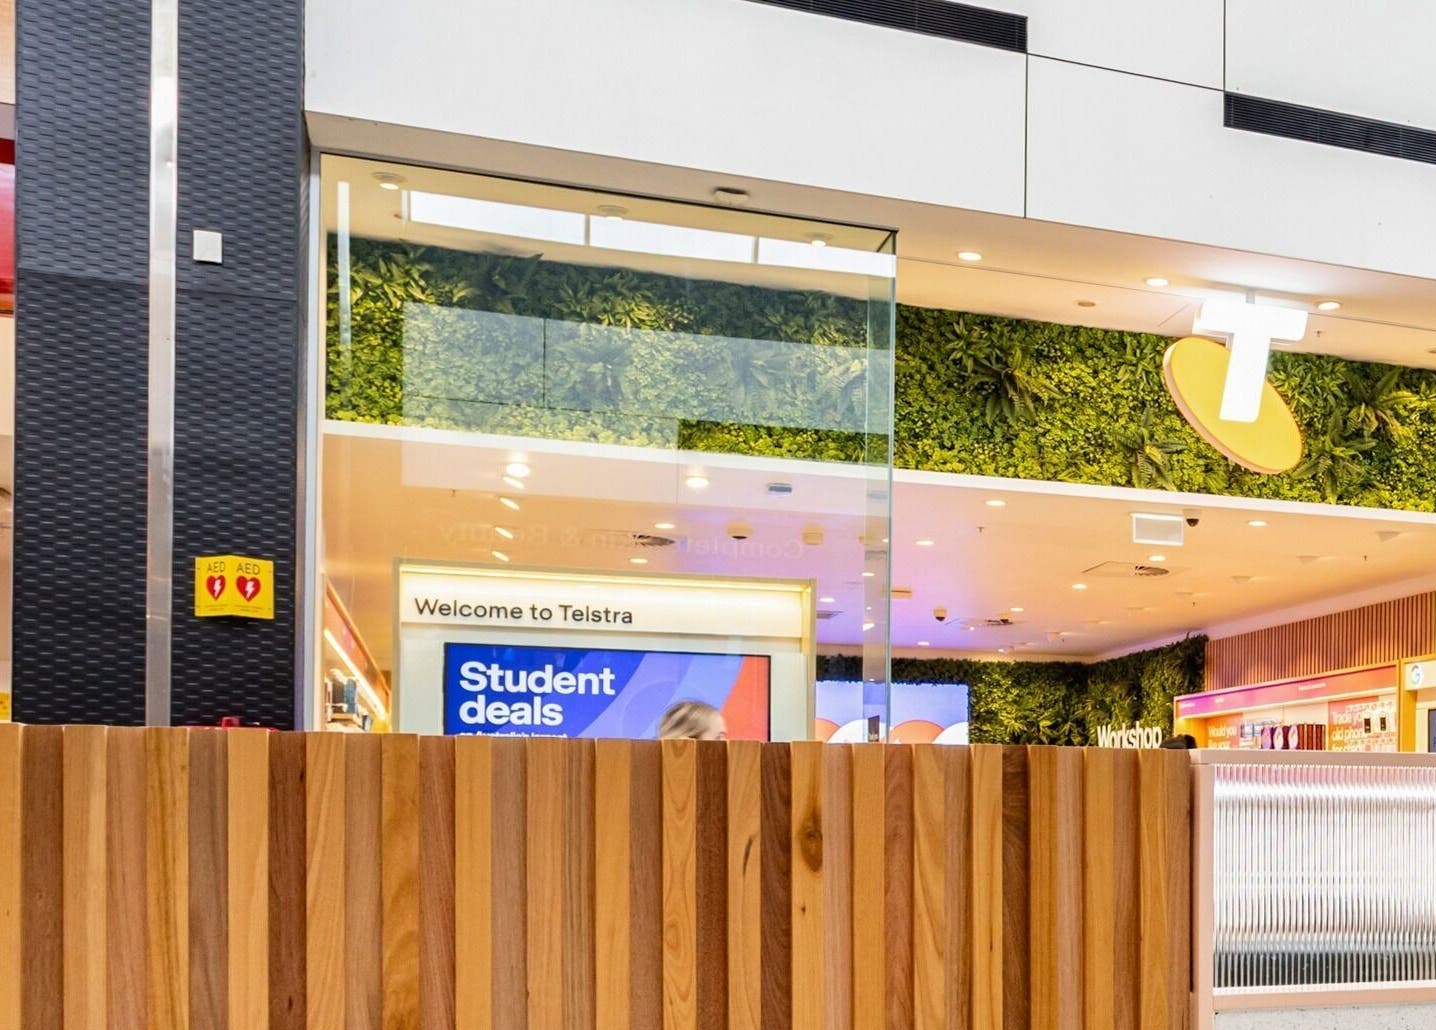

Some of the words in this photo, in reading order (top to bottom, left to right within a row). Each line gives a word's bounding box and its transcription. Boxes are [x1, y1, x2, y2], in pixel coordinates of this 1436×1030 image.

[207, 561, 226, 573] AED
[236, 562, 261, 576] AED
[414, 597, 523, 620] Welcome
[529, 602, 553, 621] to
[558, 603, 633, 625] Telstra
[459, 660, 616, 696] Student
[458, 695, 564, 727] deals
[1096, 720, 1163, 748] Workshop
